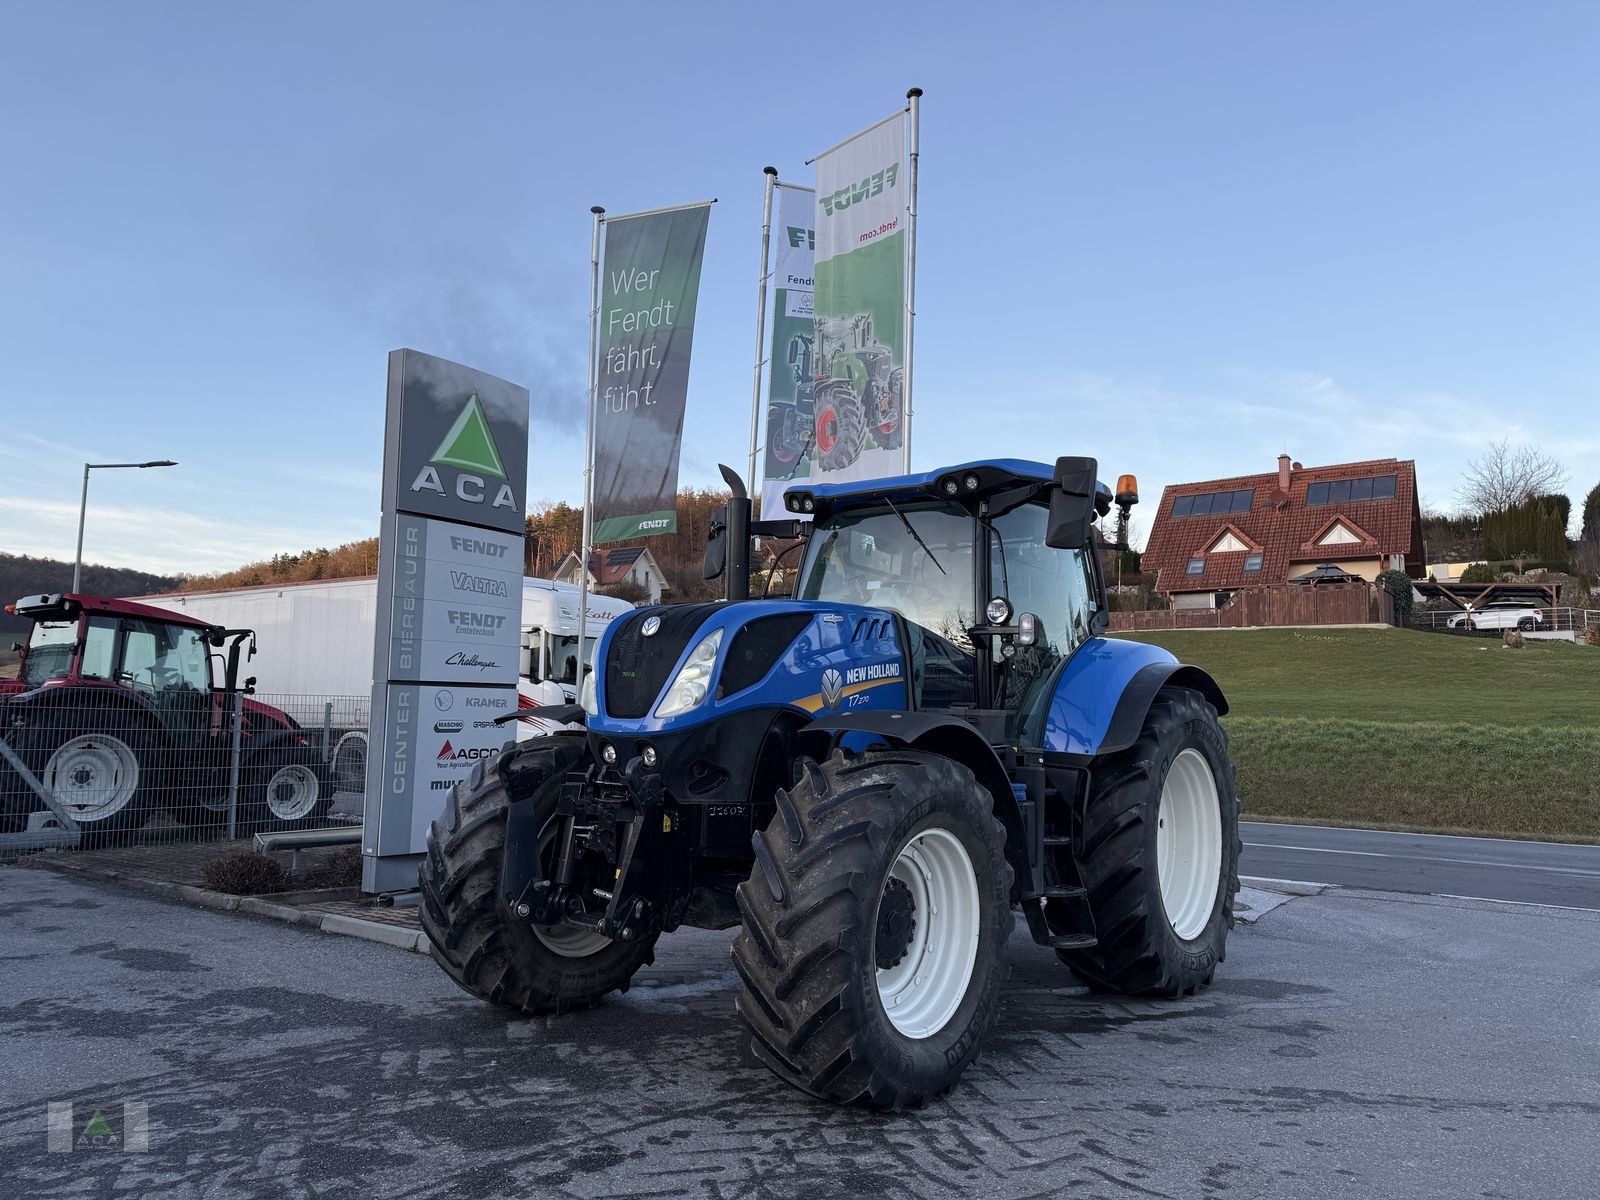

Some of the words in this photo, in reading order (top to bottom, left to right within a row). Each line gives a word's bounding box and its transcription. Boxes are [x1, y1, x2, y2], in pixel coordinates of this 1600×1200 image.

[612, 267, 660, 295] Wer
[609, 298, 674, 335] Fendt
[606, 342, 661, 375] fährt,
[604, 381, 656, 415] führt.
[410, 465, 518, 513] ACA
[638, 519, 670, 530] FENDT
[450, 536, 508, 558] FENDT
[400, 527, 418, 669] BIERBAUER
[449, 570, 508, 598] VALTRA
[447, 610, 506, 629] FENDT
[445, 651, 503, 672] Challenger
[846, 665, 867, 684] NEW
[867, 663, 899, 680] HOLLAND
[465, 697, 508, 709] KRAMER
[472, 720, 505, 729] GASPAO
[393, 691, 411, 794] CENTER
